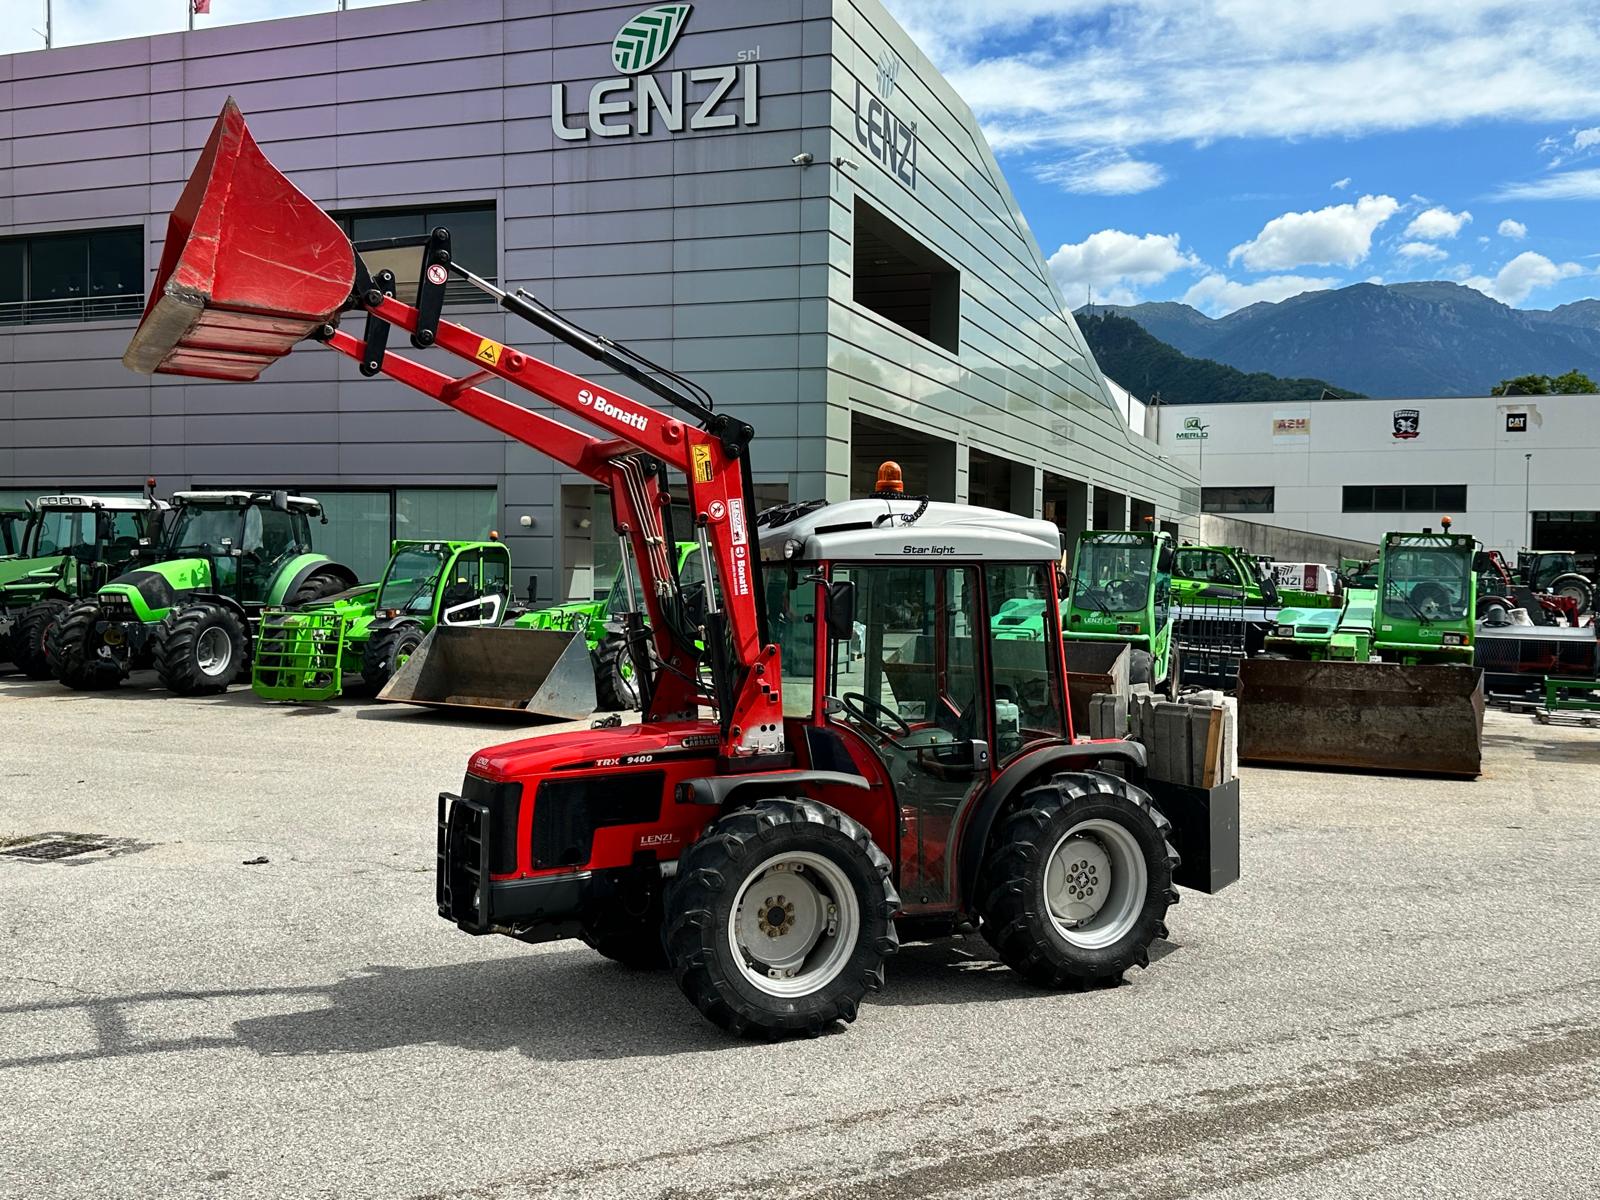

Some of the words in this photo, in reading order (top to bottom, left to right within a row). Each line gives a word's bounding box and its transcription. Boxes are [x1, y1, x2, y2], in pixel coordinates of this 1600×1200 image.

[737, 46, 761, 62] srl
[551, 64, 760, 141] LENZI
[854, 80, 918, 191] LENZI
[593, 395, 649, 431] Bonatti
[1508, 417, 1525, 427] CAT
[903, 545, 929, 554] Star
[931, 545, 955, 556] light
[737, 559, 749, 595] Bonatti
[596, 758, 620, 767] TRX
[627, 755, 653, 764] 9400
[640, 833, 673, 843] LENZI
